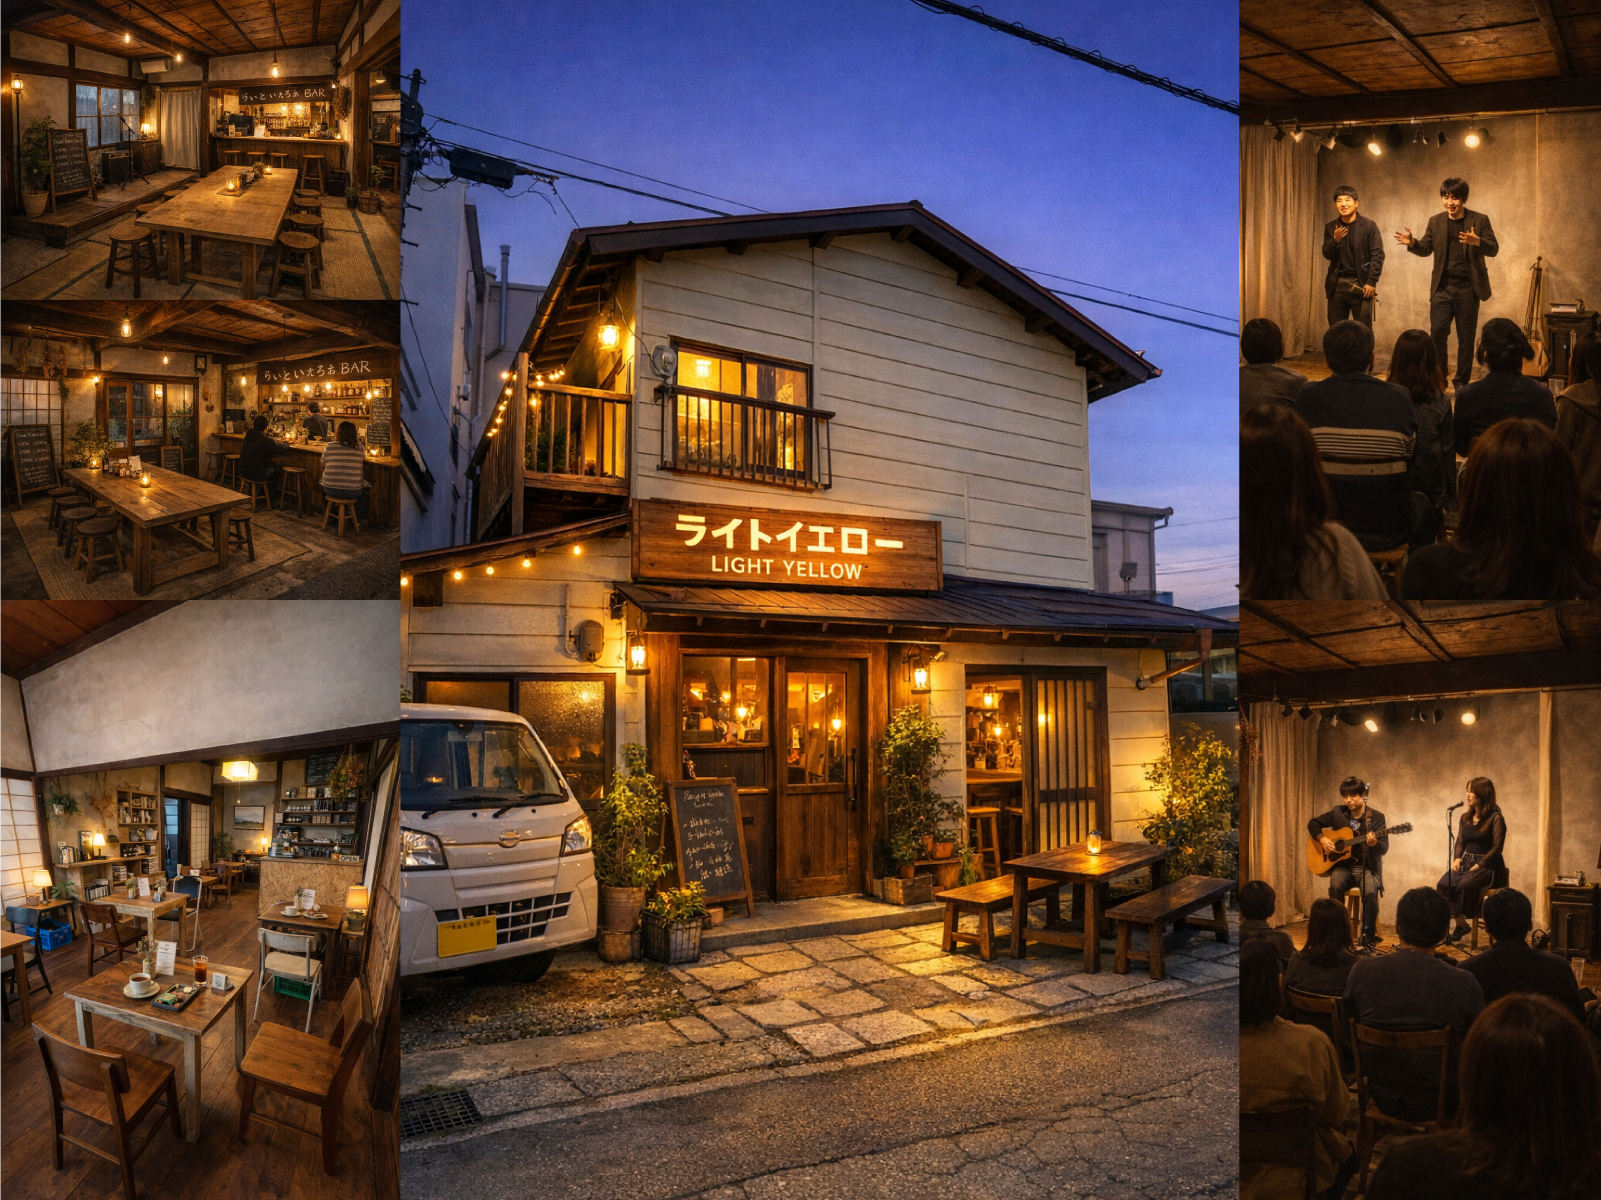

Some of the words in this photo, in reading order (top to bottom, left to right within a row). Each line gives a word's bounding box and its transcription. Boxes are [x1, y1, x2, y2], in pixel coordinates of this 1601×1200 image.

[304, 88, 326, 98] BAR
[341, 360, 371, 375] BAR
[675, 514, 904, 556] ライトイエロー
[711, 555, 774, 575] LIGHT
[782, 559, 862, 580] YELLOW
